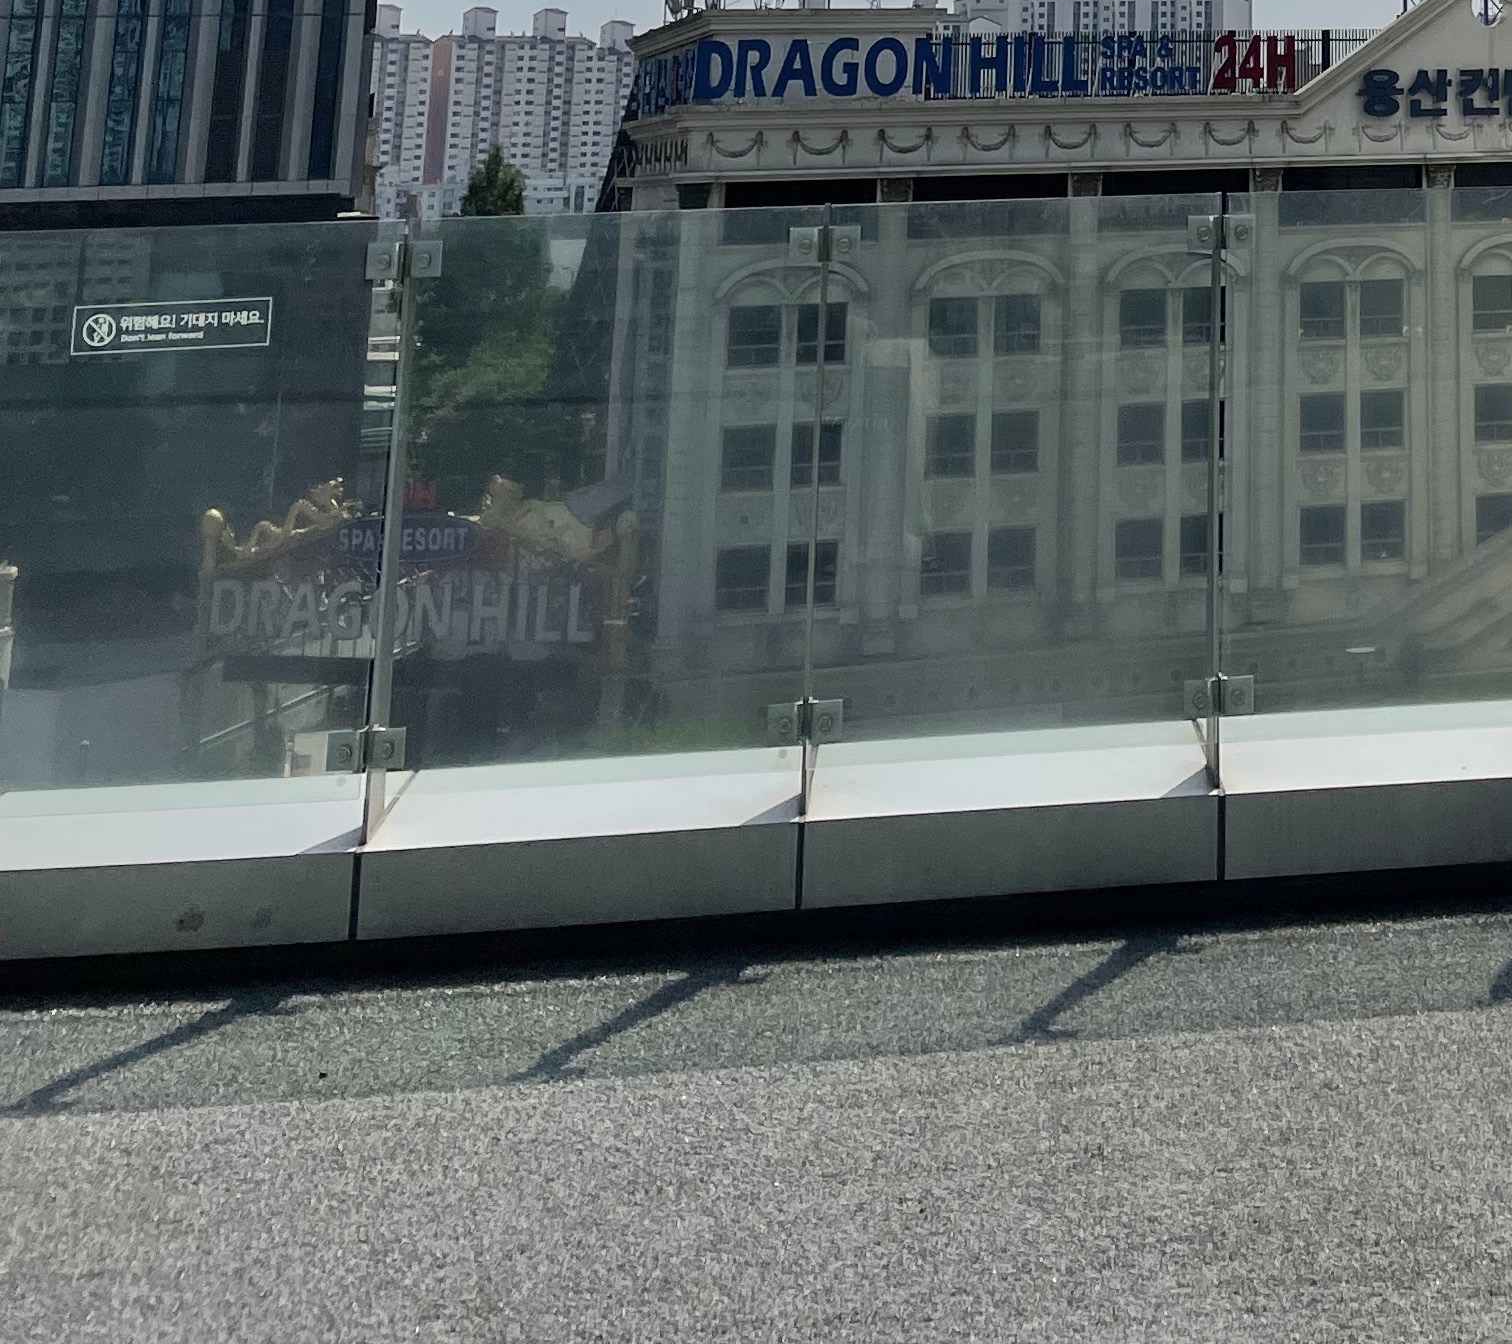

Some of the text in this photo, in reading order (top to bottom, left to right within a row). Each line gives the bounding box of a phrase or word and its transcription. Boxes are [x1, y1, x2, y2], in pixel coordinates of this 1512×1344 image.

[1101, 34, 1147, 60] SPA
[1212, 31, 1296, 89] 24H
[693, 37, 952, 100] DRAGON
[970, 35, 1089, 95] HILL
[1101, 65, 1201, 91] RESORT
[180, 312, 219, 329] 기대지
[168, 331, 204, 340] forward
[338, 526, 469, 552] SPA ESORT
[468, 578, 595, 644] HILL
